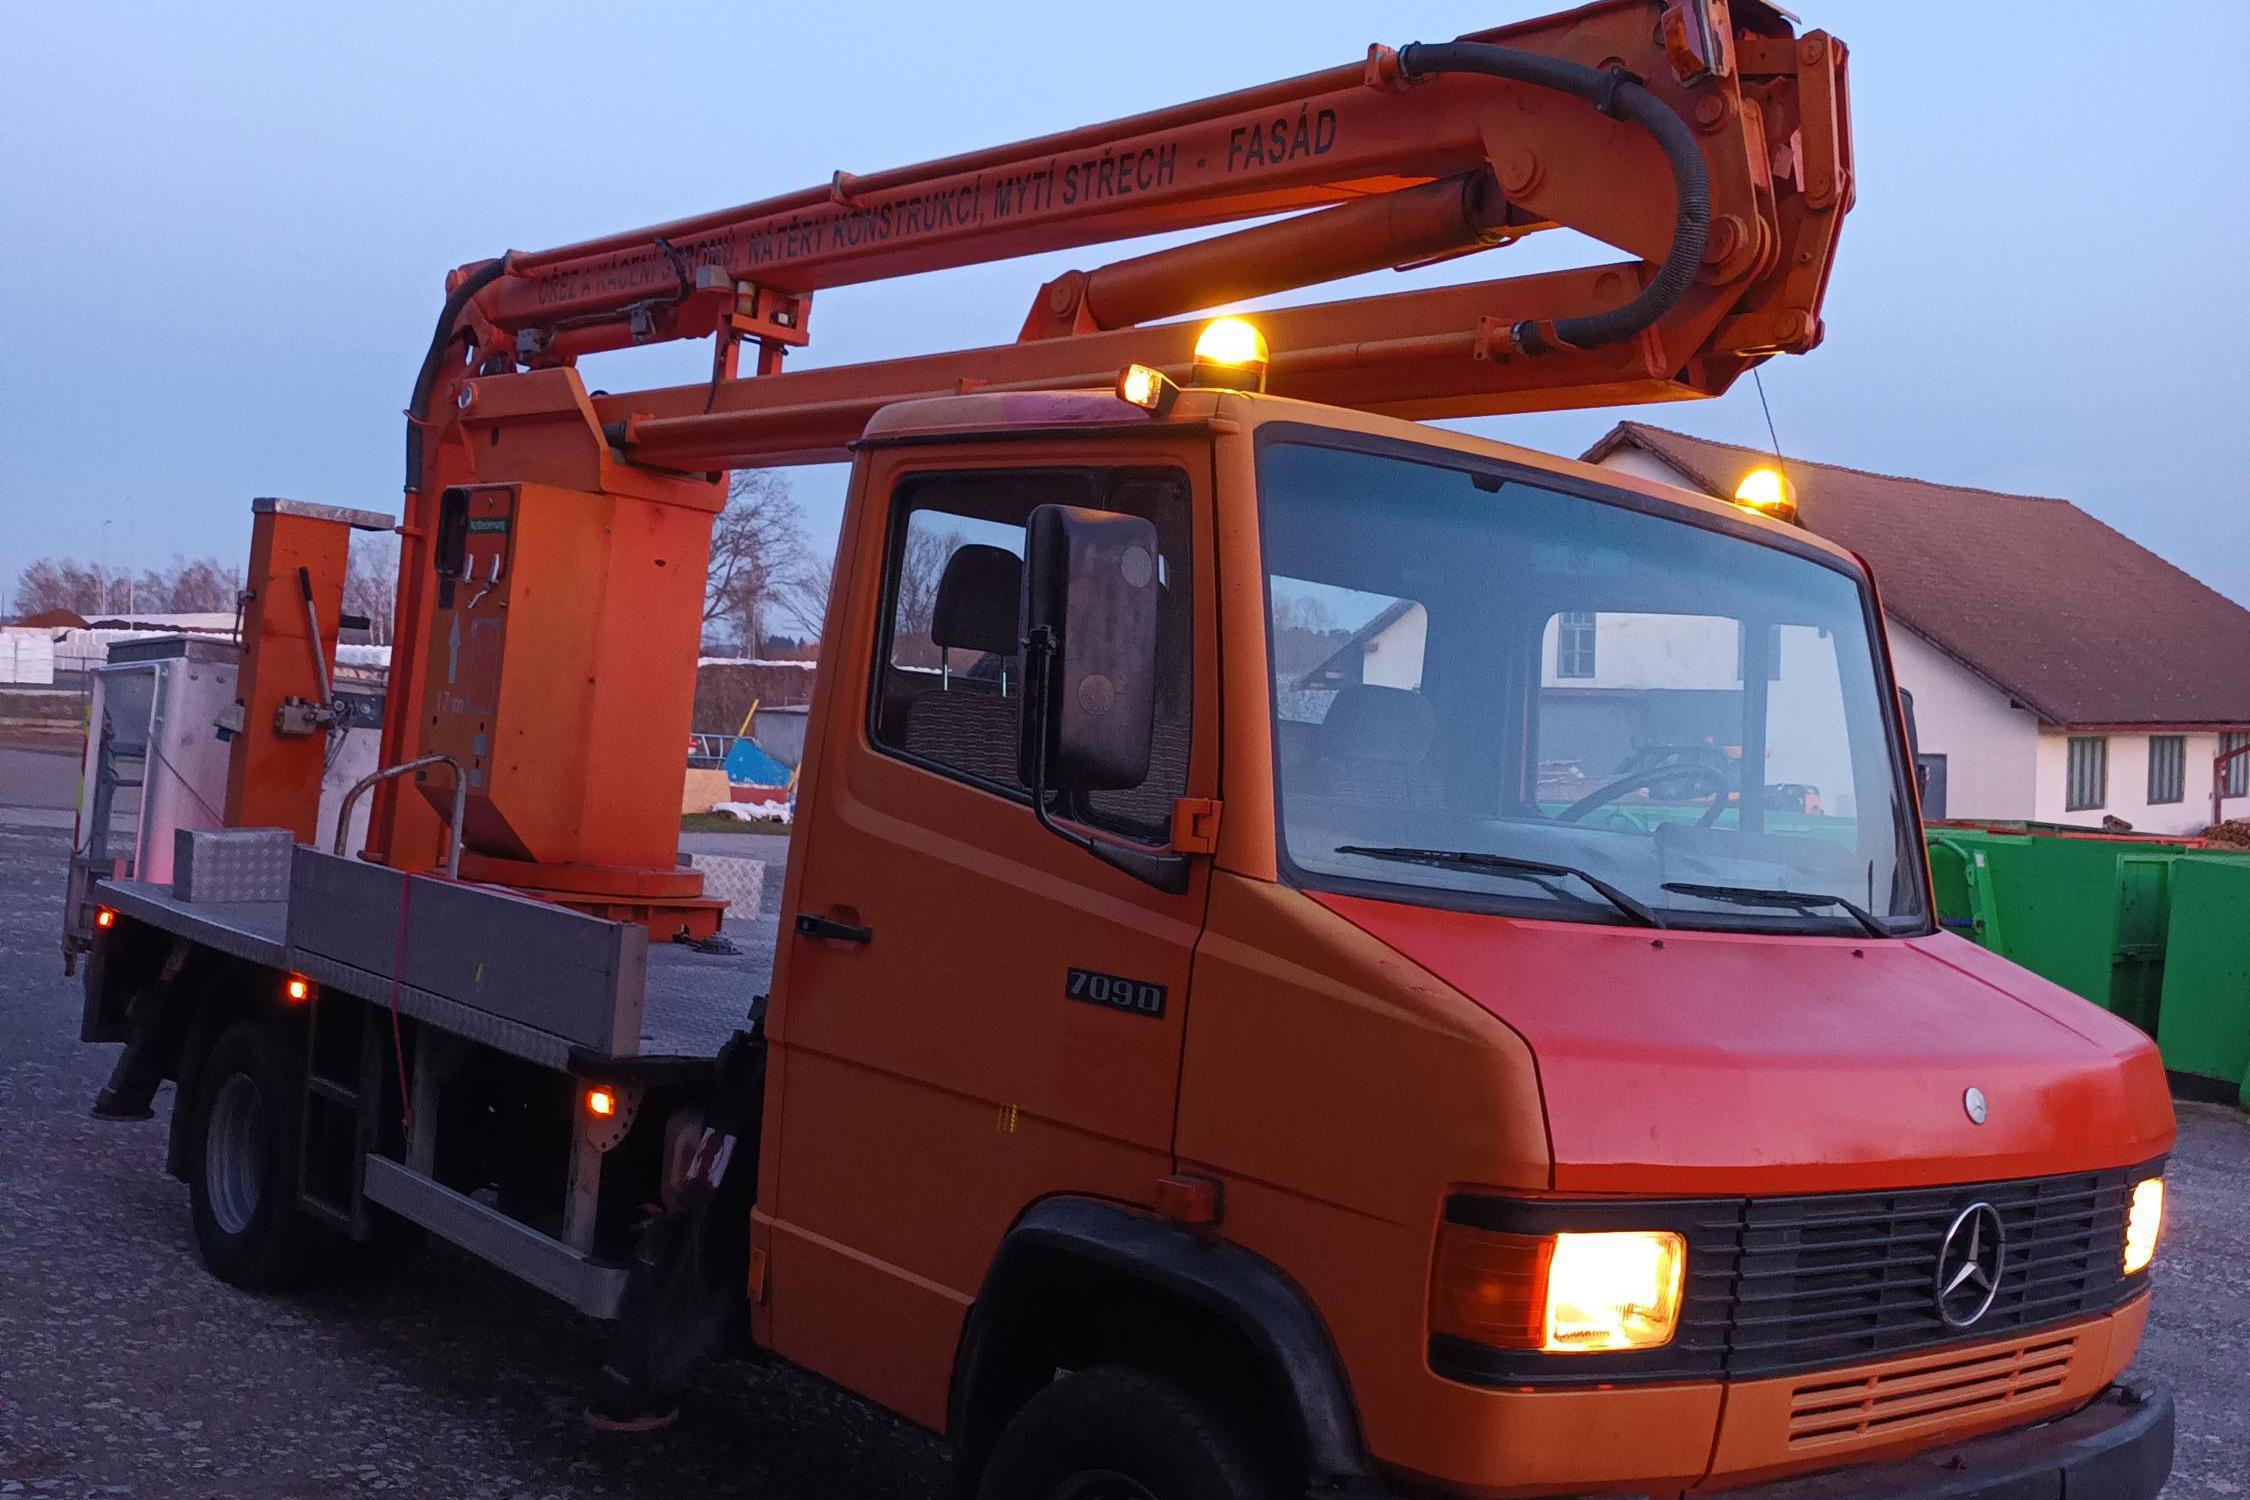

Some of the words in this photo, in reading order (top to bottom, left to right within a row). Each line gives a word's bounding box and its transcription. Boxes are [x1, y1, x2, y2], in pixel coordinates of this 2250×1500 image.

[992, 158, 1056, 220] MYTÍ
[1062, 142, 1177, 205] STŘECH
[1226, 102, 1337, 173] FASÁD
